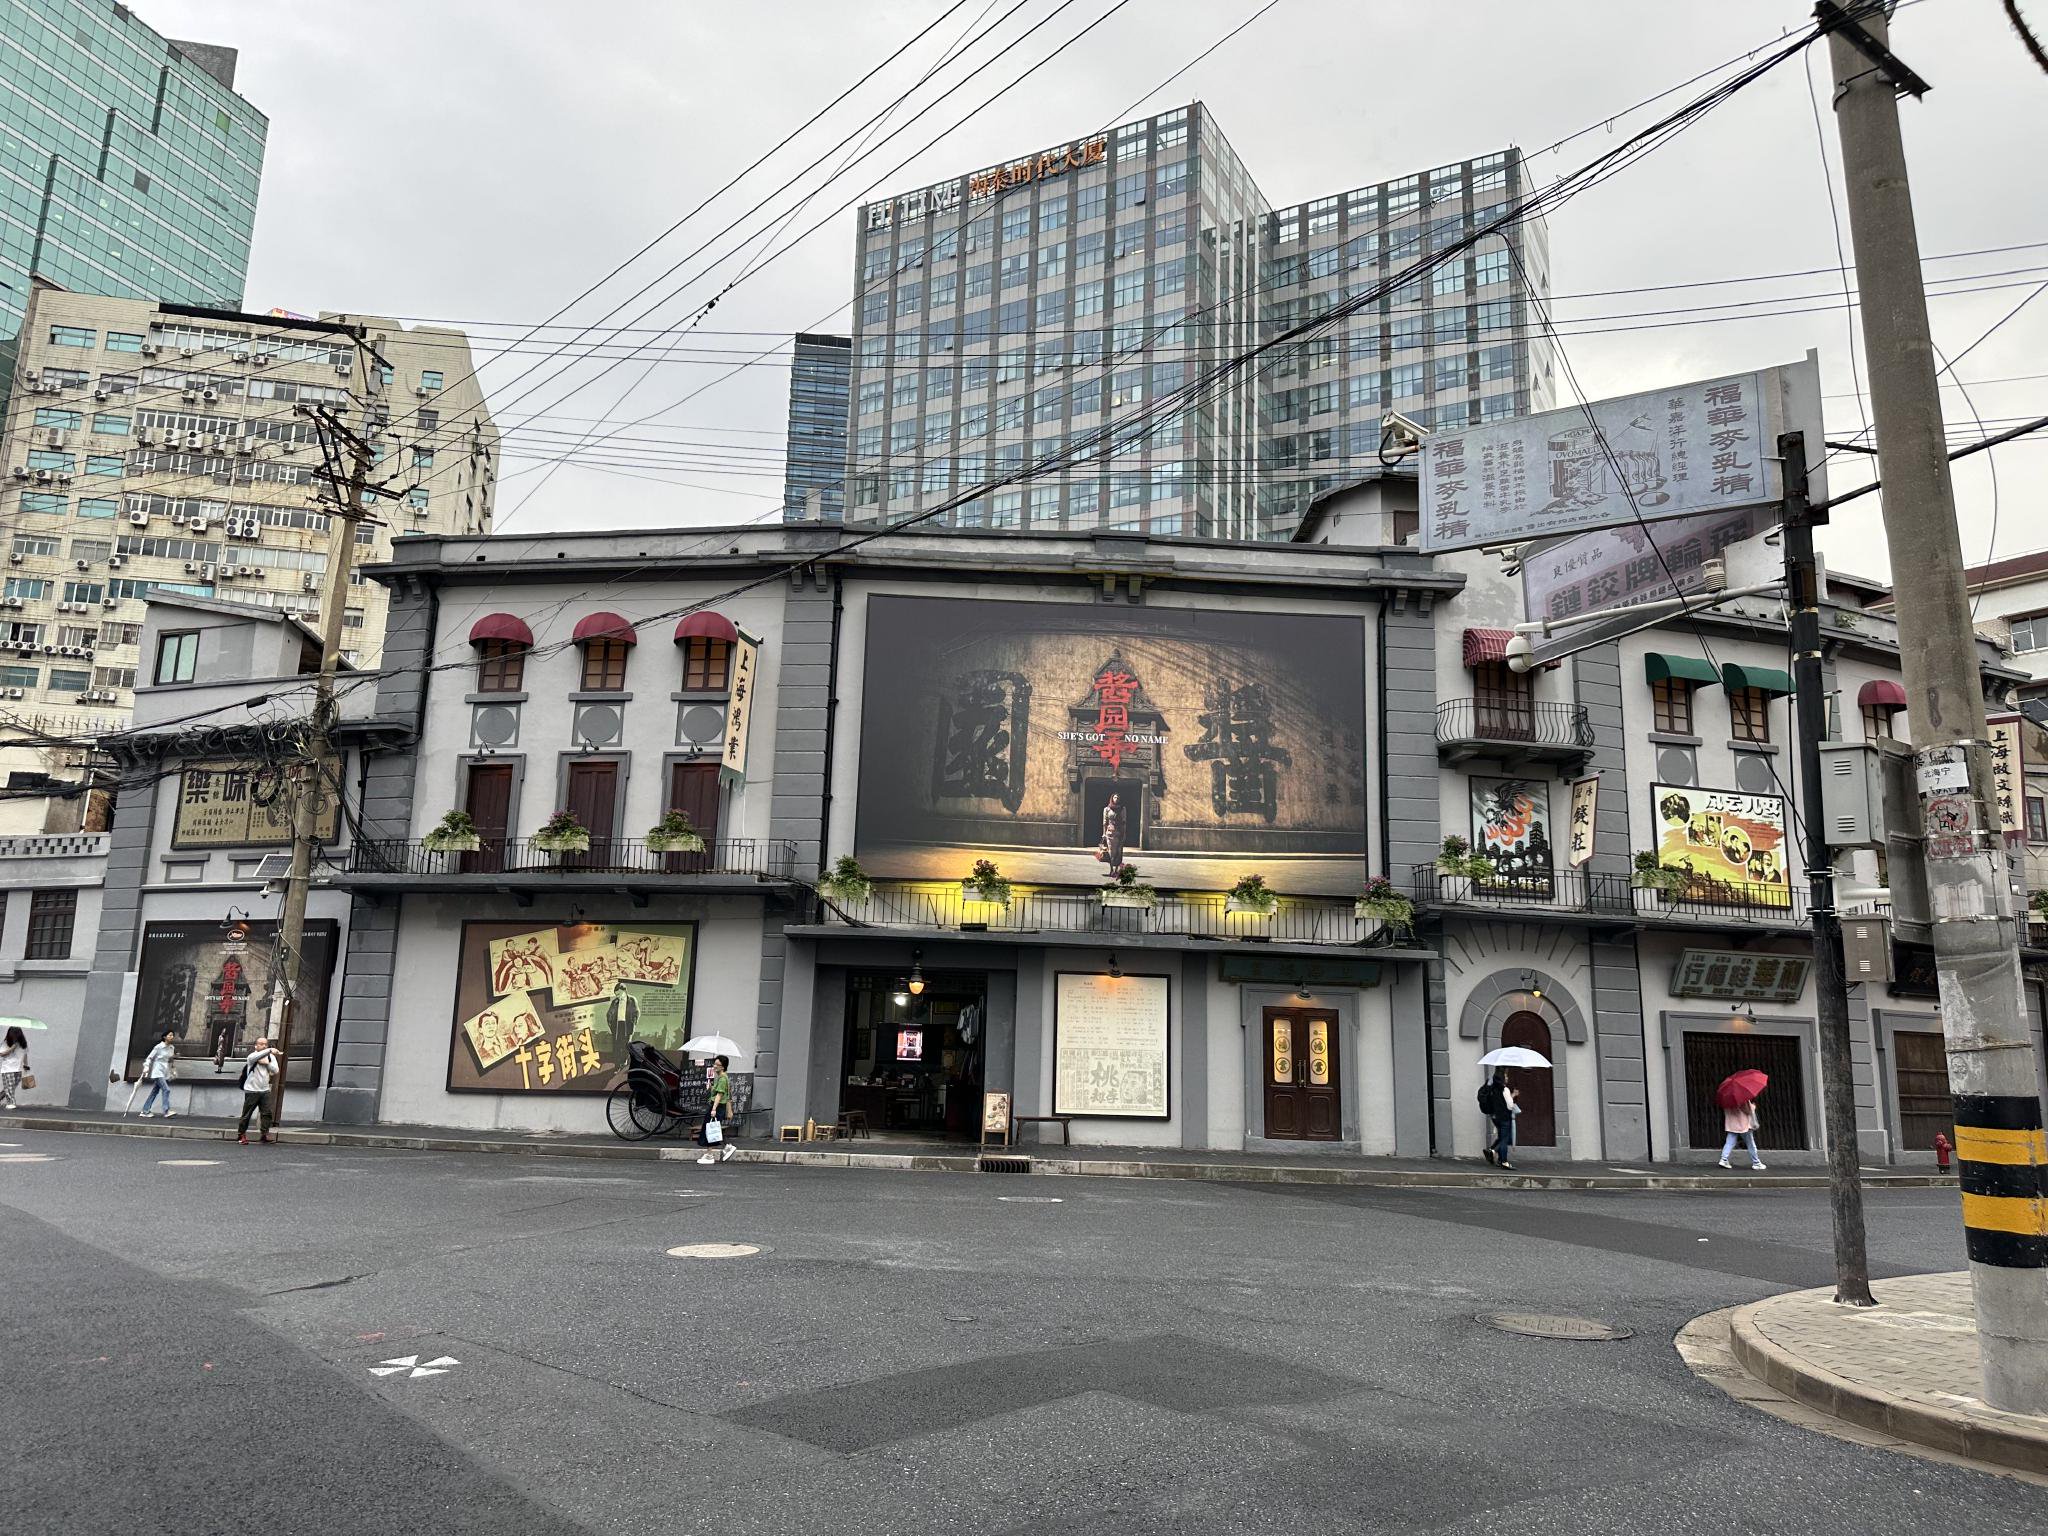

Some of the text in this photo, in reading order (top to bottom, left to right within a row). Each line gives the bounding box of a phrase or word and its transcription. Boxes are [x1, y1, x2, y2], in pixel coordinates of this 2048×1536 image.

[1703, 383, 1754, 496] 福華麥乳精
[1432, 438, 1472, 540] 福華麥乳精
[1057, 732, 1169, 744] SHE'S GOT NO NAME
[515, 1027, 601, 1090] 十字街头
